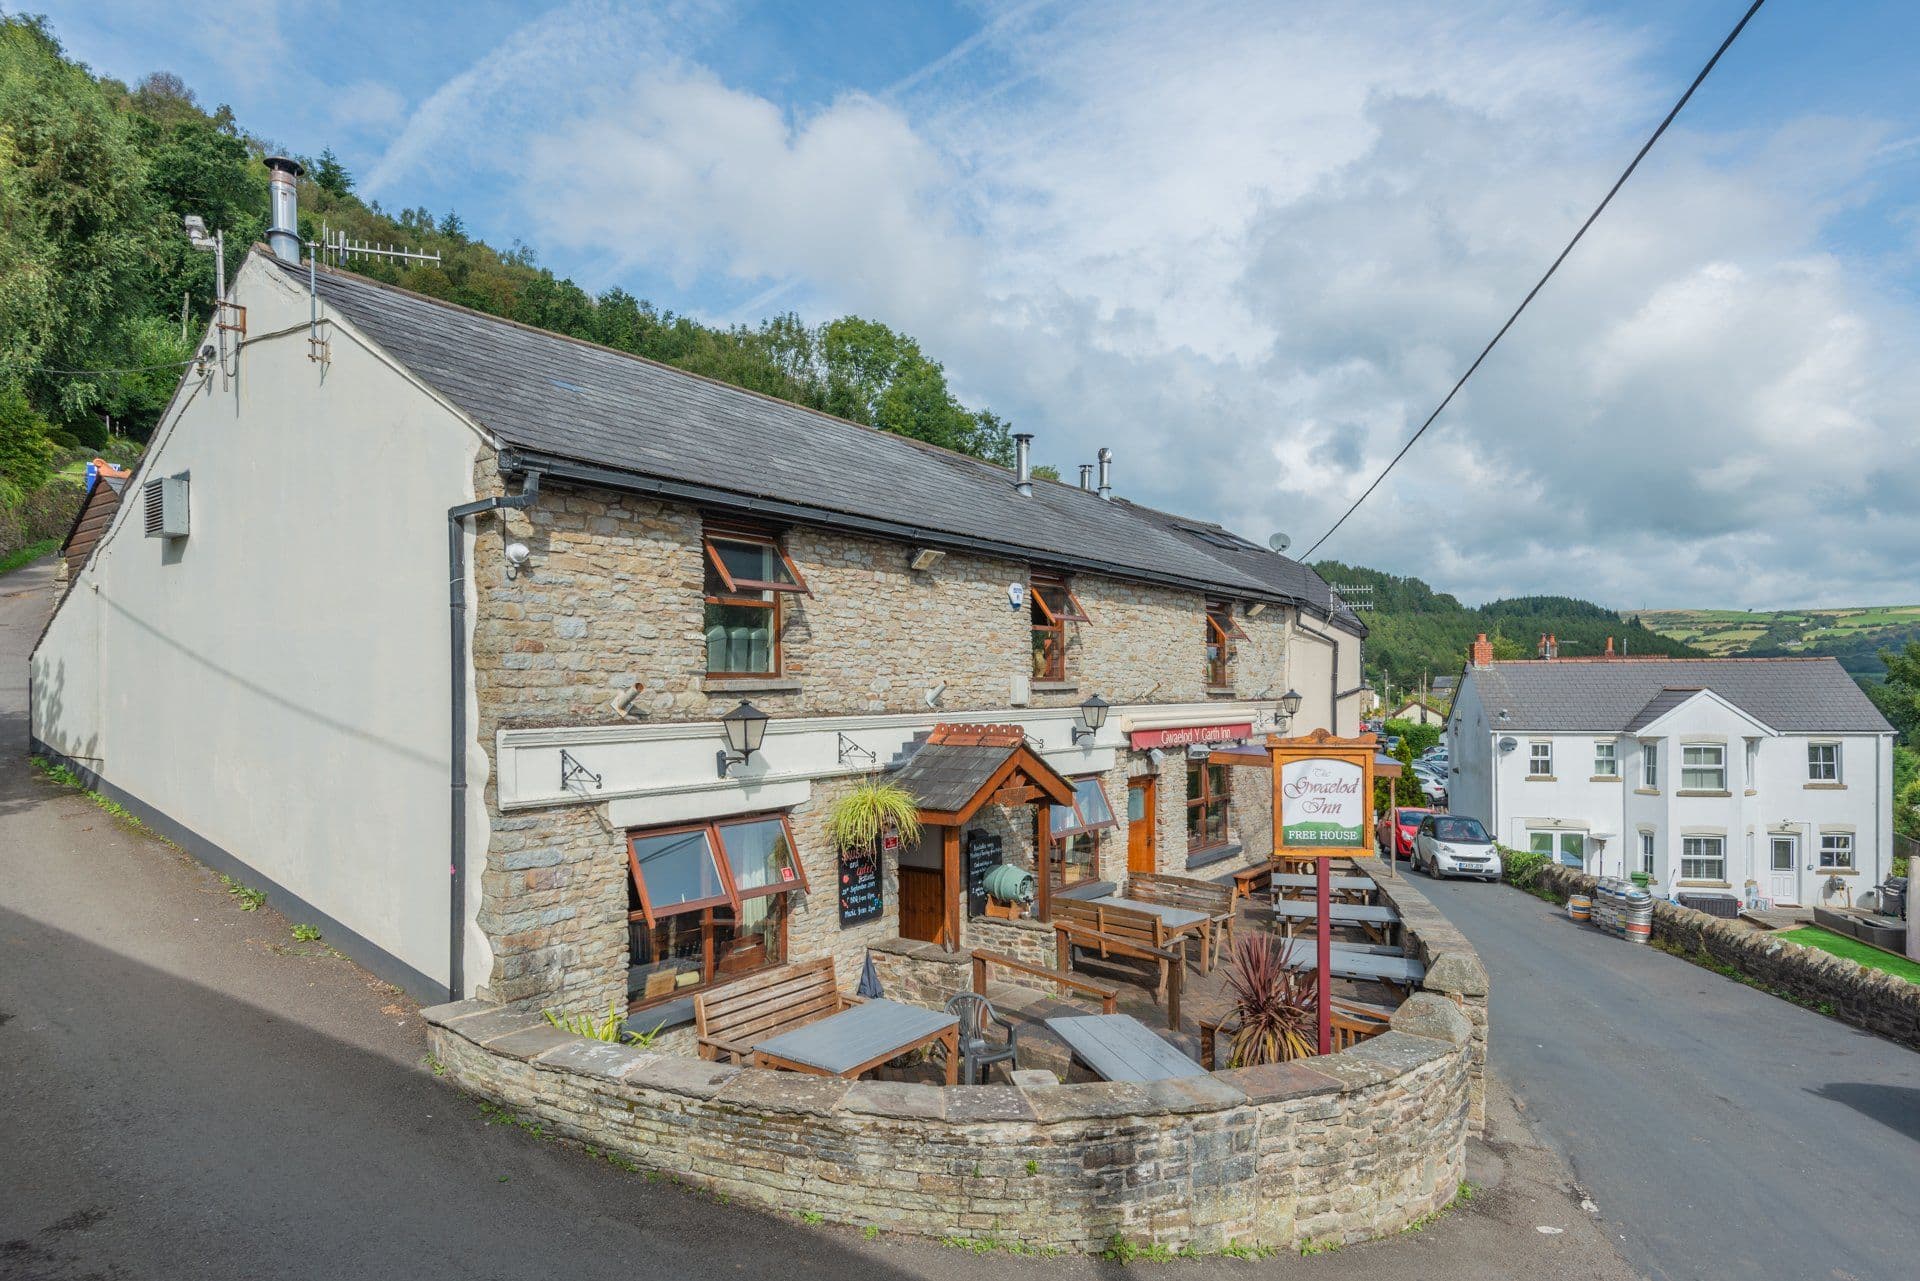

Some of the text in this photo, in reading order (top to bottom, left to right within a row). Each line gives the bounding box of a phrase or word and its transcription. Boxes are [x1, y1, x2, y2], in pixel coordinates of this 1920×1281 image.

[1161, 727, 1231, 745] Gwaelod Y Garth Inn
[1312, 768, 1332, 777] The
[1284, 776, 1360, 799] Gwaelod
[1302, 797, 1342, 814] Inn
[1288, 830, 1358, 840] FREE HOUSE
